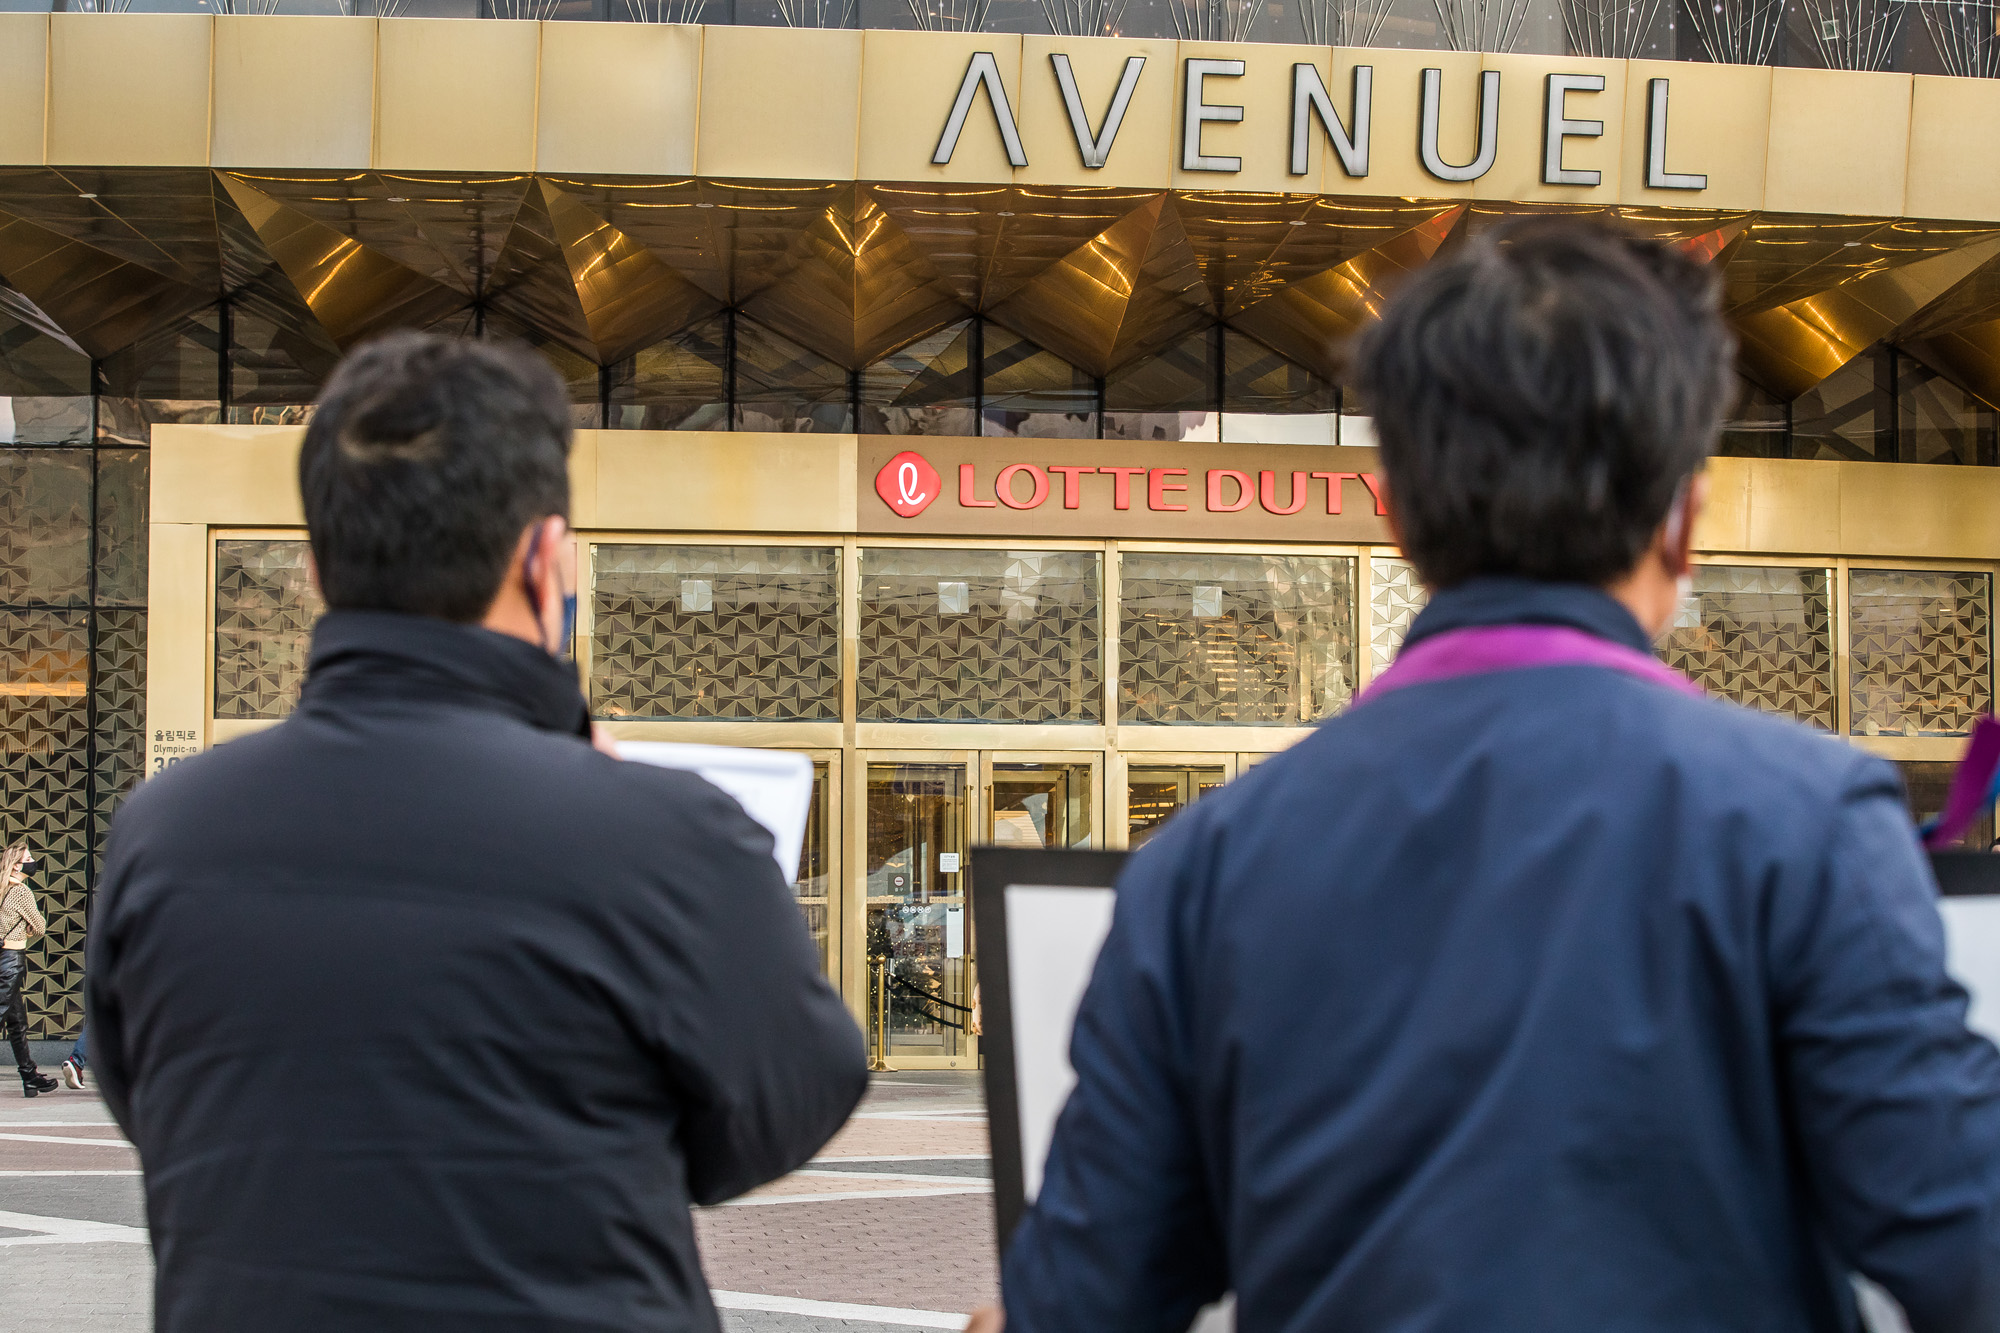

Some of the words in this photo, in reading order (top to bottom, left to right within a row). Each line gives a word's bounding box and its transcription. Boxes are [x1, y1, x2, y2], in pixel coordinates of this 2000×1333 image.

[930, 51, 1708, 191] AVENUEL
[957, 463, 1189, 512] LOTTE
[154, 730, 197, 742] 올림픽로
[154, 744, 197, 755] Olympic-ro
